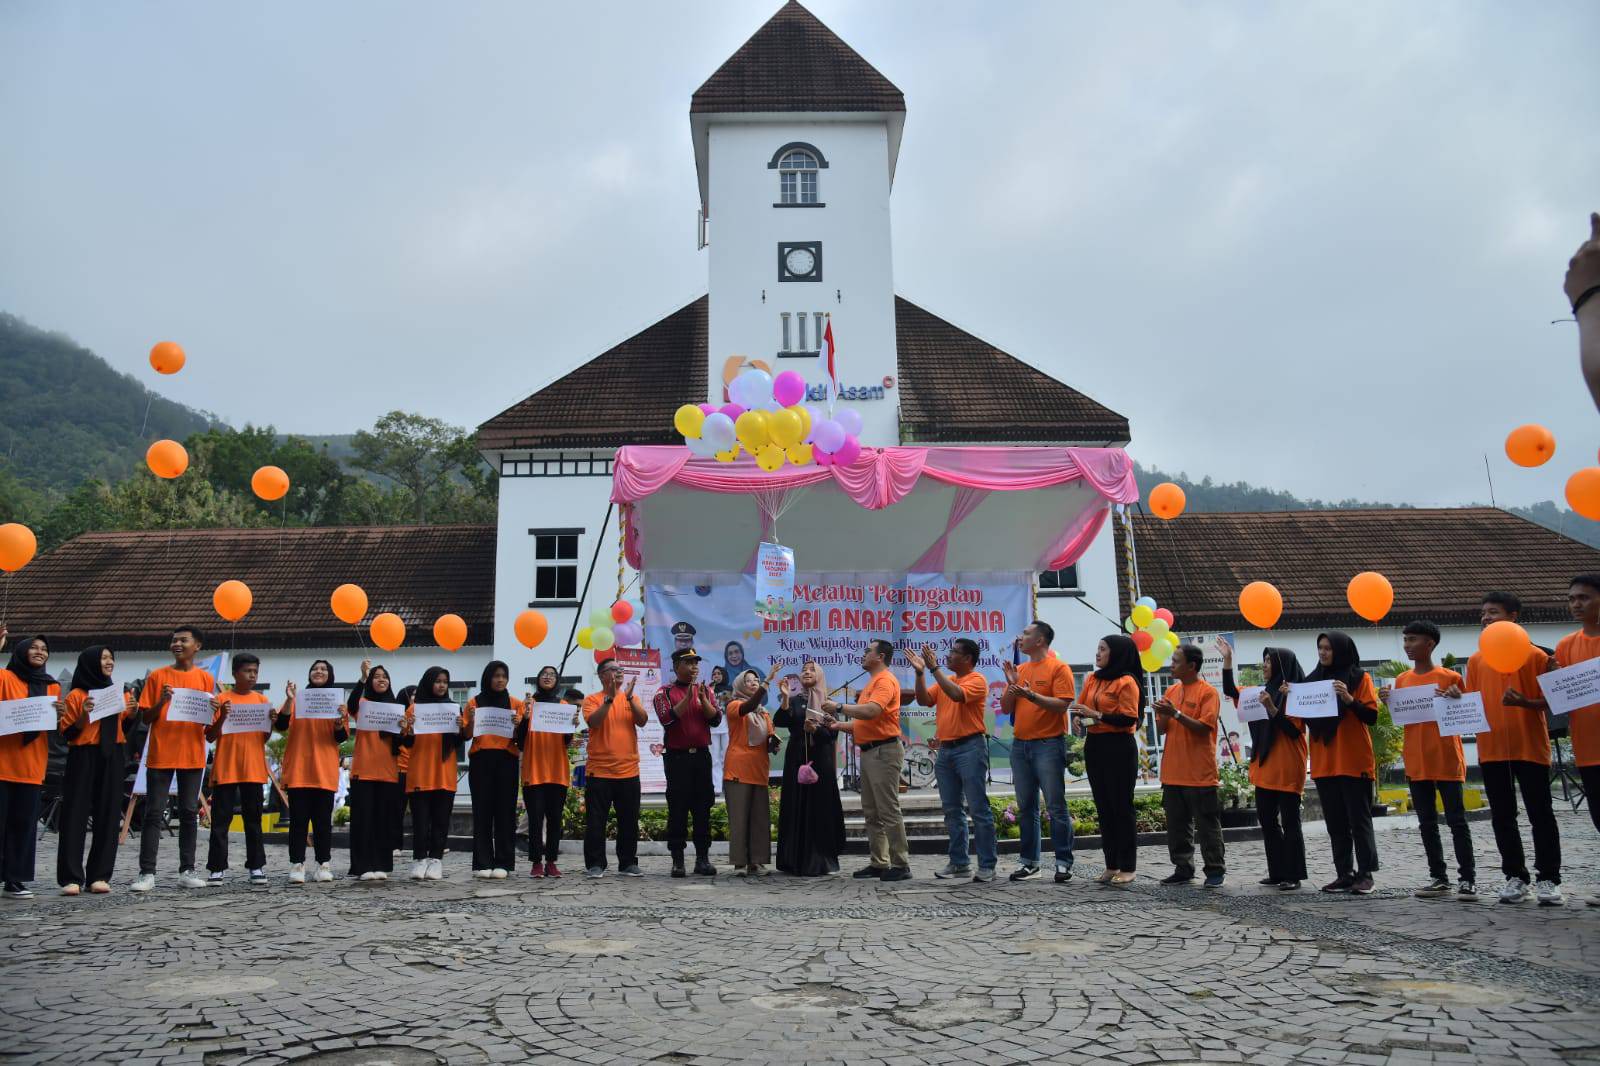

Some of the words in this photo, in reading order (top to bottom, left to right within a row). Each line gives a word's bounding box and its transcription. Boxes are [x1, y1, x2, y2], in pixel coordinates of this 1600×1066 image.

[836, 382, 884, 401] Asam
[793, 584, 864, 603] Melalui
[869, 584, 983, 609] Peringatan
[828, 608, 893, 632] ANAK
[901, 609, 1005, 633] SEDUNIA
[777, 637, 806, 652] Kita
[806, 637, 868, 652] Wujudkan
[768, 654, 799, 667] Kota
[974, 655, 1001, 667] nak
